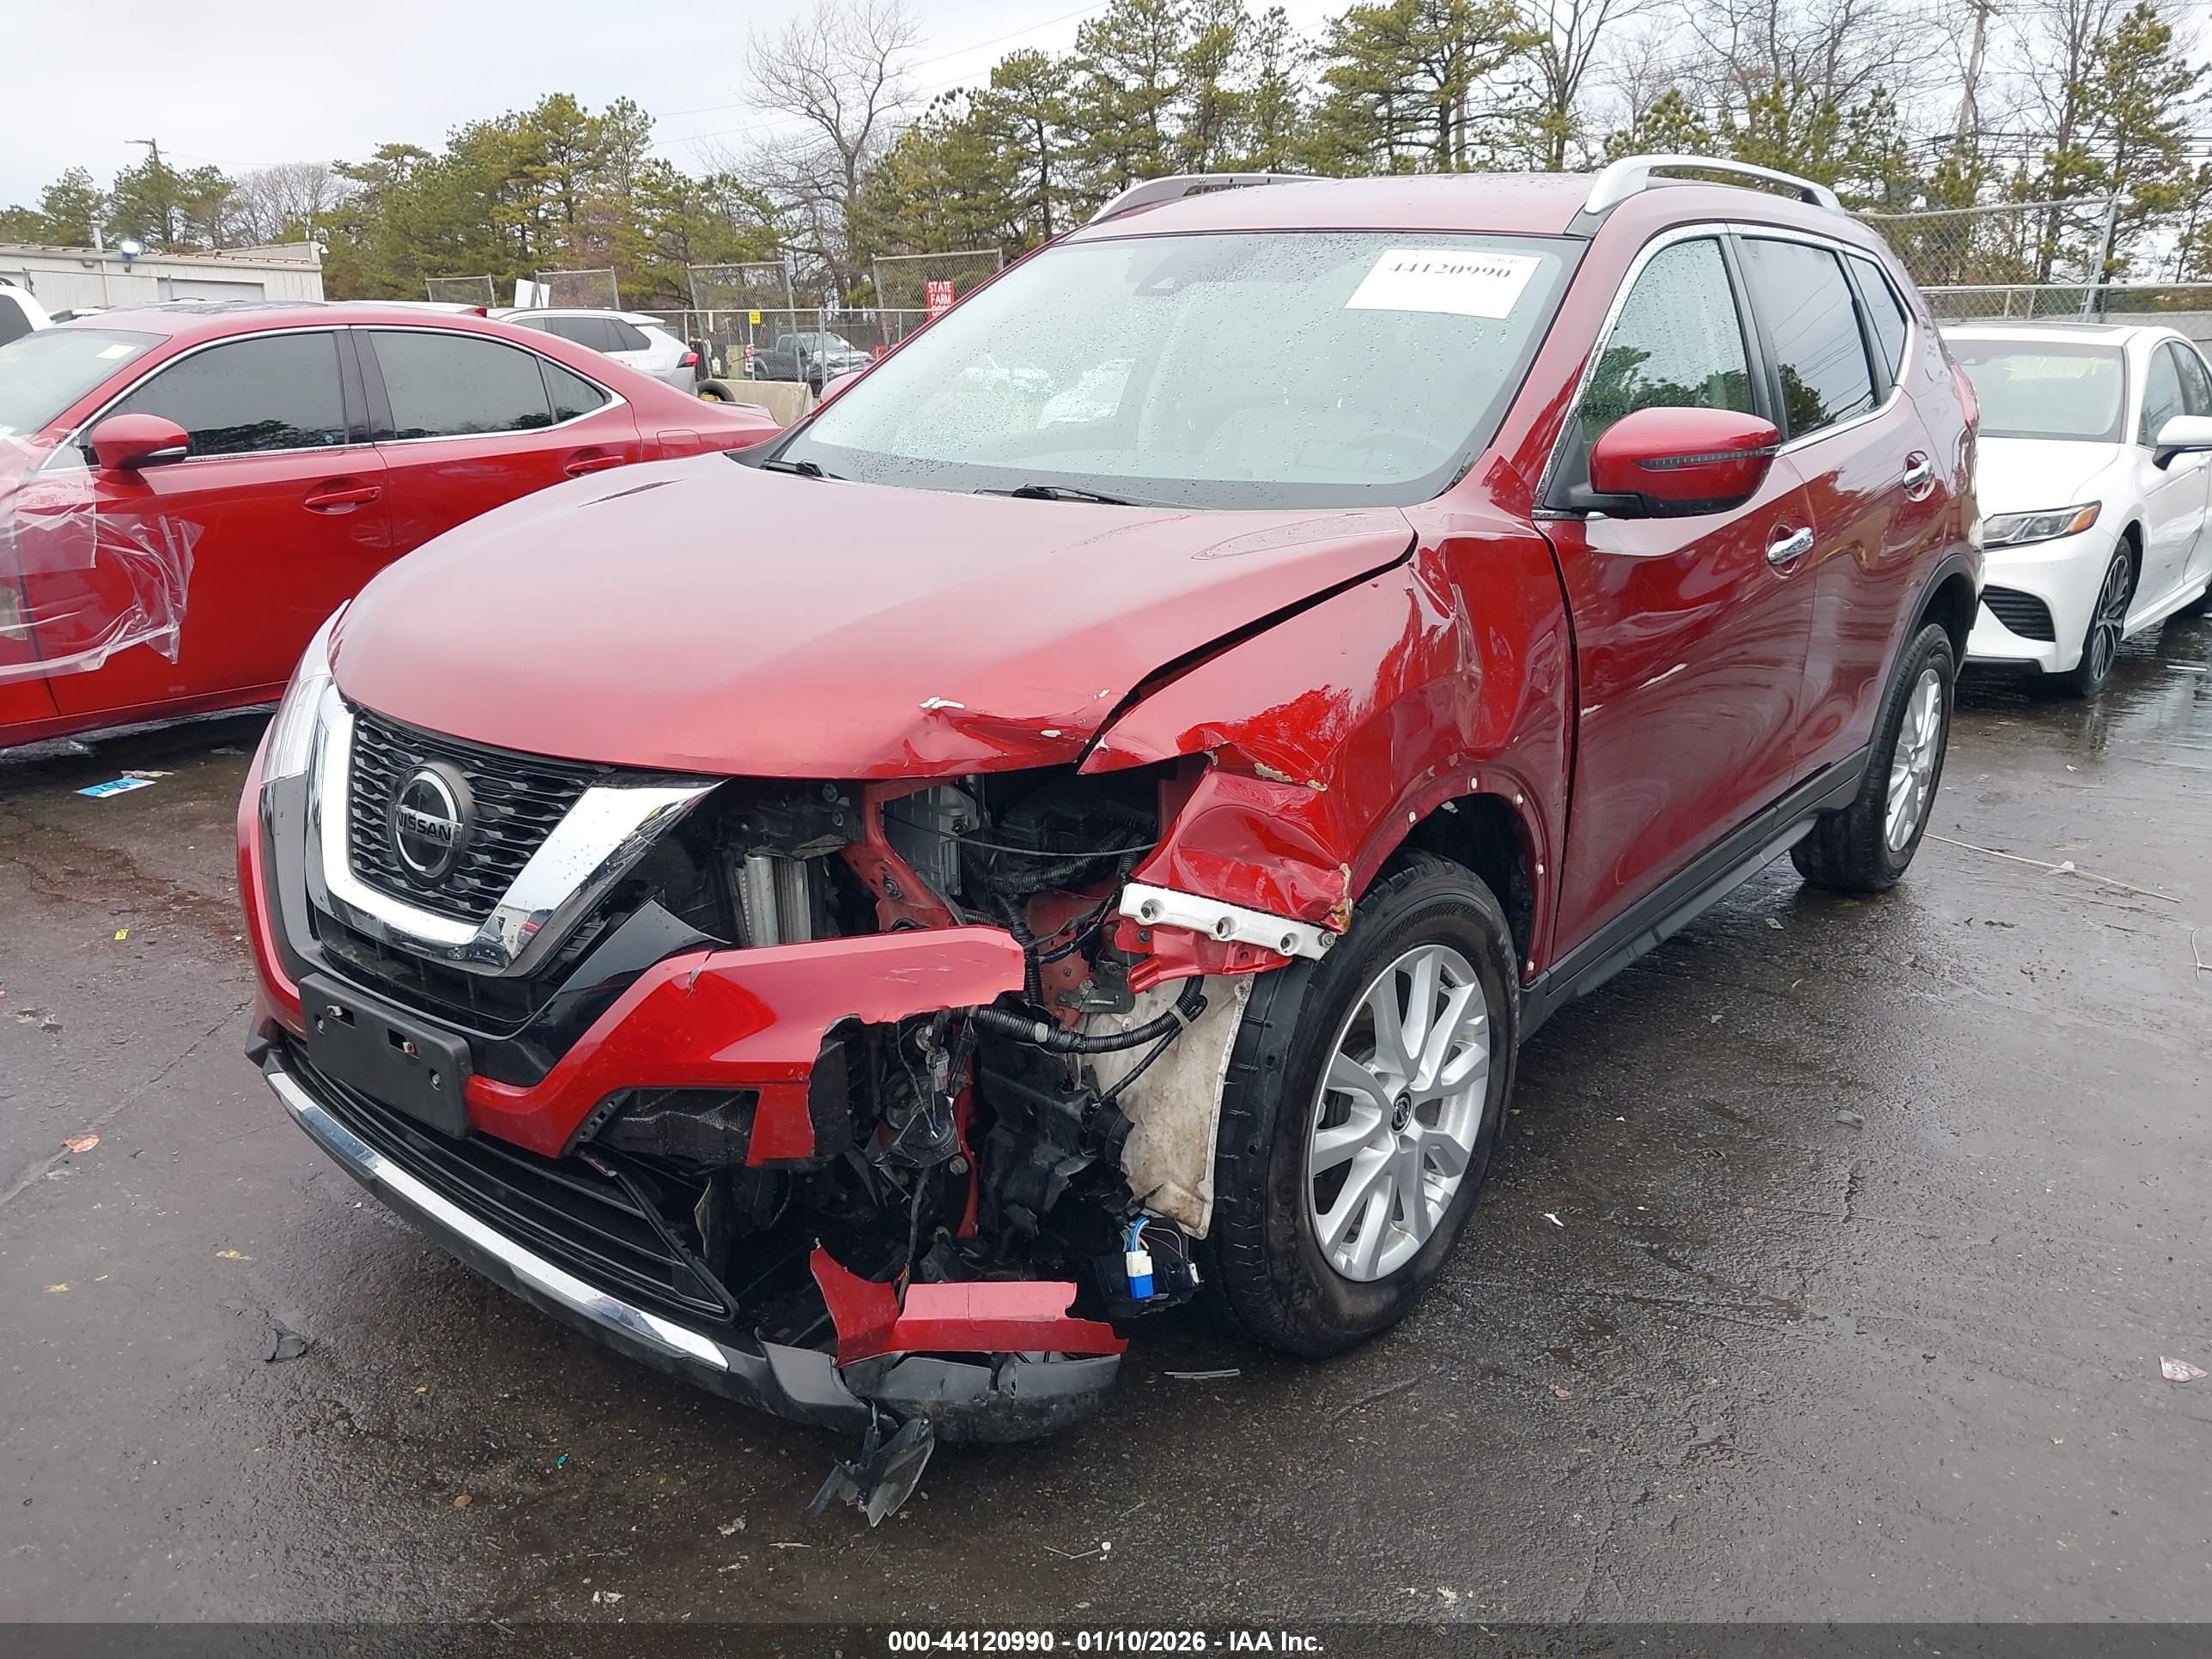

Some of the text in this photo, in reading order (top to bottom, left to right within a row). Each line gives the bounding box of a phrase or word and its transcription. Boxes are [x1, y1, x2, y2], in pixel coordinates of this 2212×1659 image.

[928, 281, 951, 293] STATE
[931, 294, 951, 305] FARM
[397, 812, 452, 842] NISSAN
